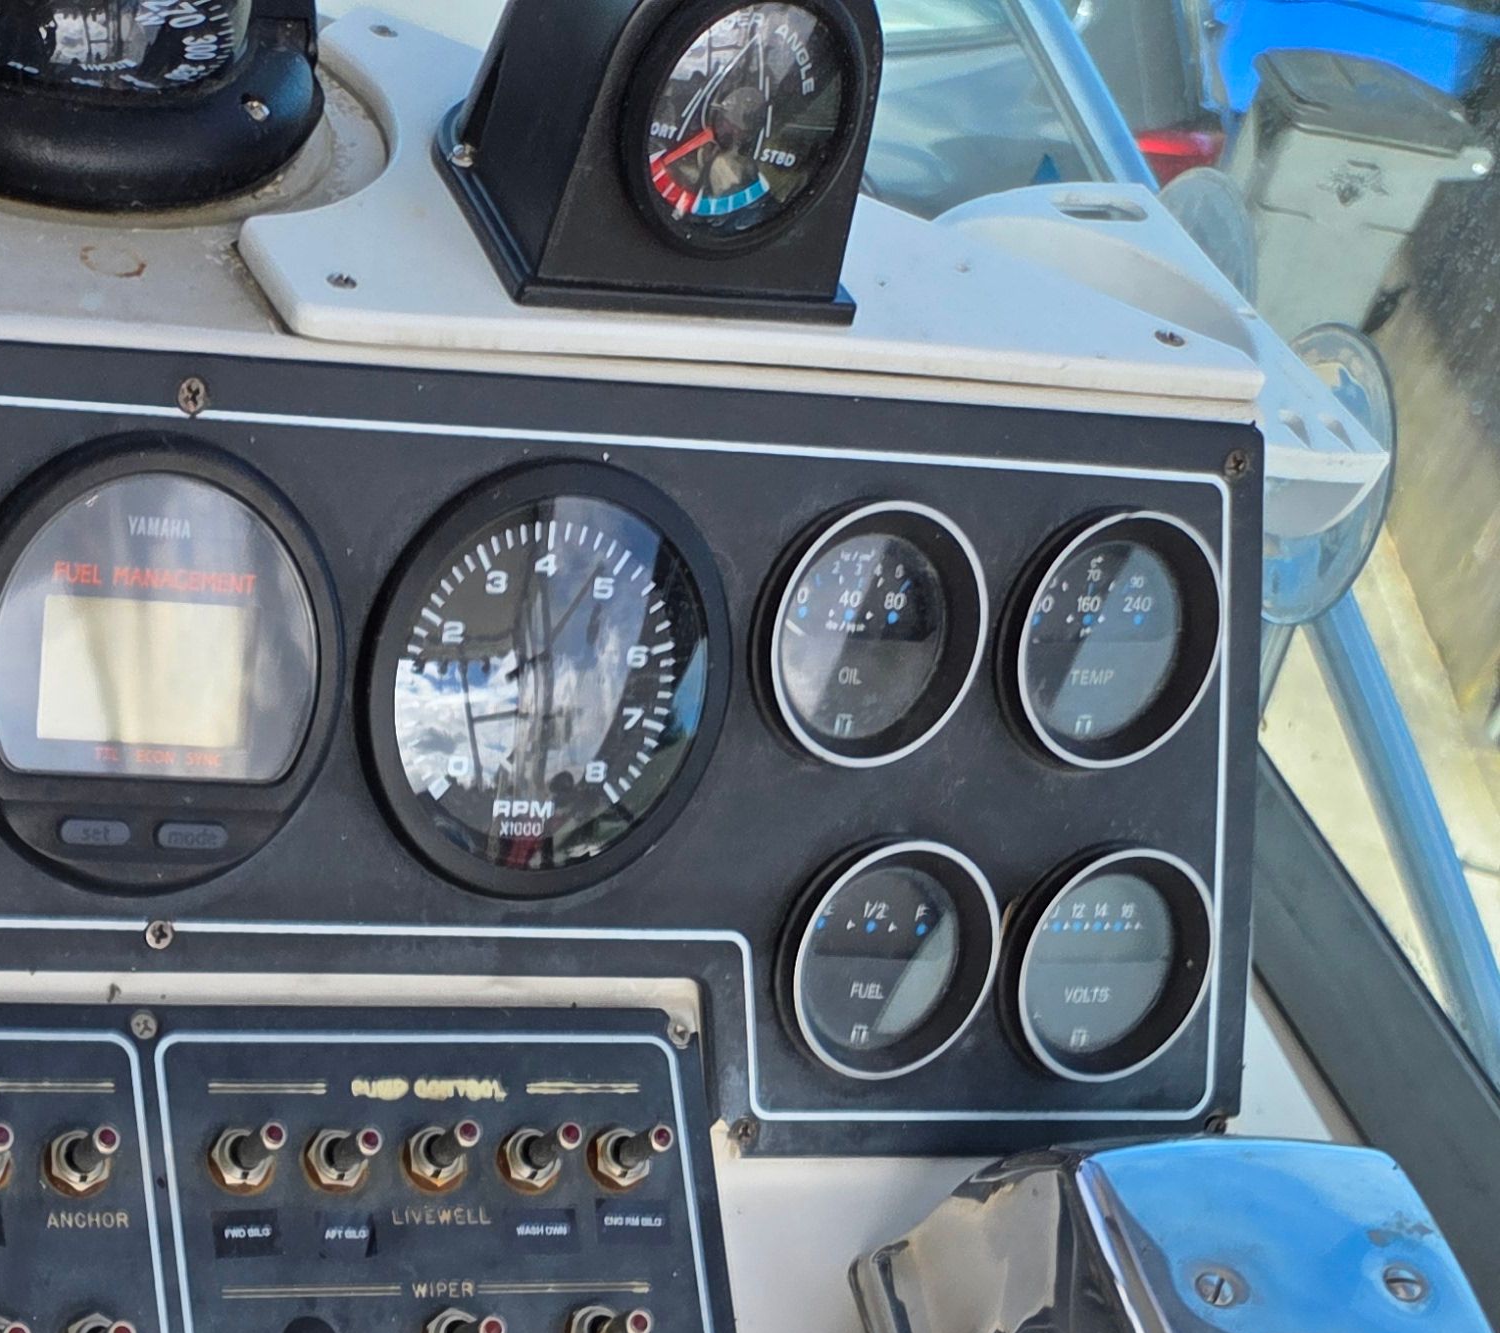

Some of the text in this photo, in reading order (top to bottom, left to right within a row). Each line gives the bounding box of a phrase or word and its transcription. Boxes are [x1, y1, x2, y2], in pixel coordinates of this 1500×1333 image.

[776, 24, 815, 95] ANGLE
[649, 121, 678, 140] ORT
[760, 148, 796, 167] STBD
[128, 515, 192, 540] YAMAHA
[534, 554, 557, 578] 4
[54, 560, 258, 595] FUEL MANAGEMENT
[485, 570, 508, 594] 3
[592, 576, 616, 600] 5
[838, 589, 863, 609] 40
[883, 591, 908, 611] 80
[1076, 595, 1101, 613] 160
[1122, 596, 1153, 613] 240
[441, 620, 466, 644] 2
[626, 645, 649, 667] 6
[838, 667, 862, 686] OIL
[1071, 669, 1115, 686] TEMP
[622, 707, 645, 731] 7
[584, 760, 608, 783] 8
[492, 800, 555, 819] RPM
[80, 823, 111, 842] set
[499, 819, 542, 837] X1000
[863, 900, 889, 920] 1/2
[850, 981, 885, 999] FUEL
[1064, 985, 1112, 1004] VOLTS
[47, 1211, 130, 1229] ANCHOR
[392, 1206, 492, 1226] LIVEWELL
[412, 1281, 476, 1299] WIPER
